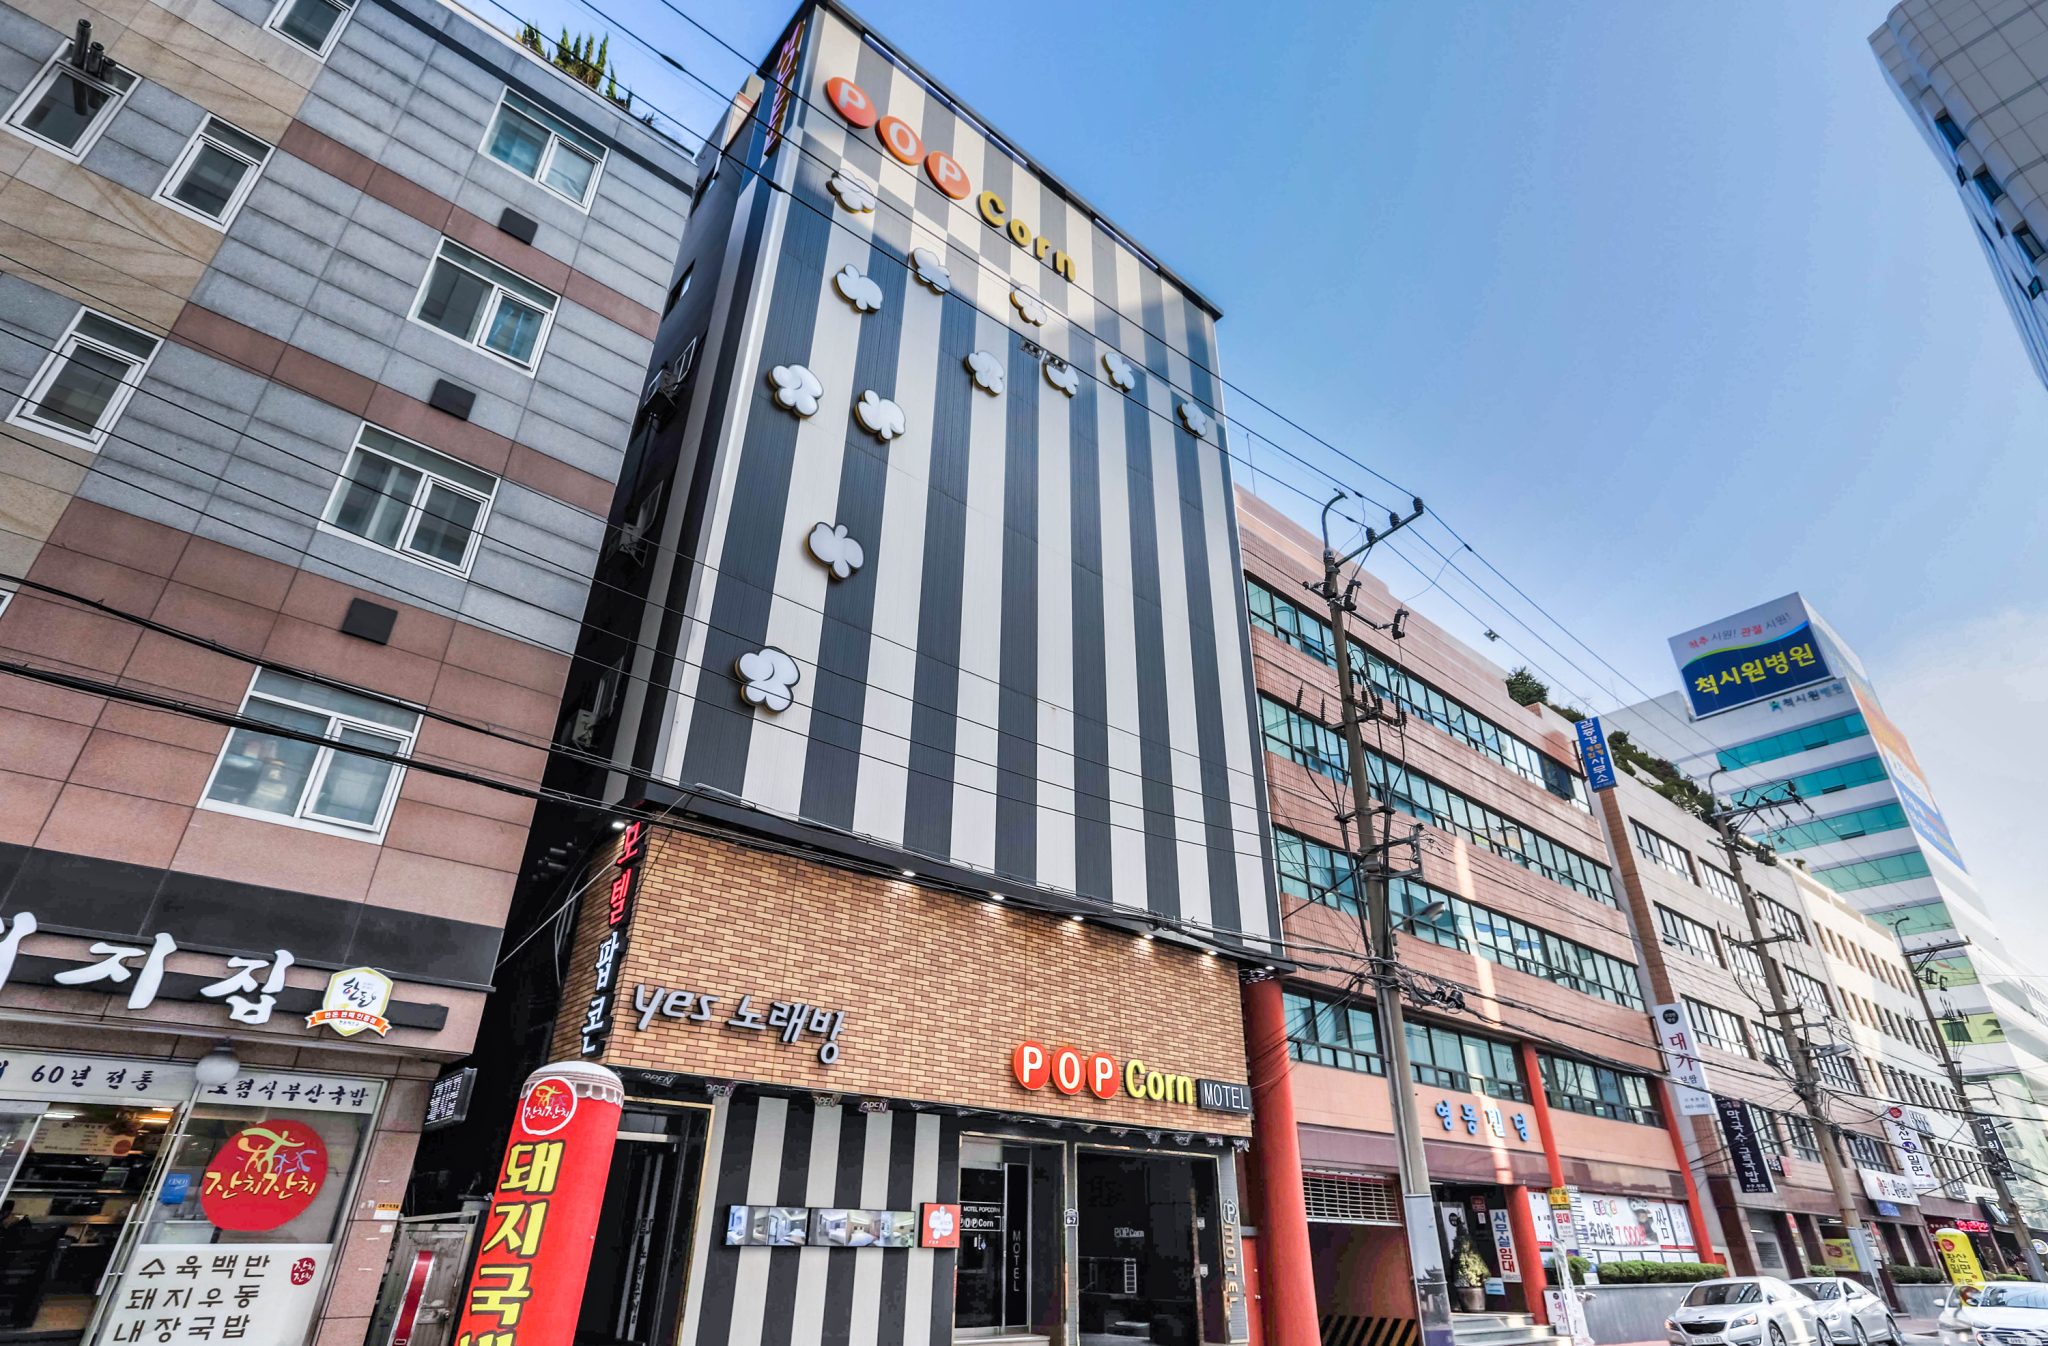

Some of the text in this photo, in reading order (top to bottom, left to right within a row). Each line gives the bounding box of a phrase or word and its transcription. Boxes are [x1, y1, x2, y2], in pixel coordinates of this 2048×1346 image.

[764, 21, 804, 158] MOTEL
[837, 81, 1076, 282] POP Corn
[1689, 612, 1792, 648] 척추 시원! 관절 시원!
[1694, 643, 1816, 695] 척시원병원
[1782, 682, 1845, 707] 척시원병원
[581, 821, 641, 1054] 모텔 팝콘
[0, 911, 295, 1025] 지집
[635, 984, 846, 1064] yes 노래방
[1669, 1032, 1699, 1071] 대가
[31, 1065, 91, 1088] 60년
[106, 1068, 154, 1091] 전통
[1022, 1045, 1249, 1110] POP Corn MOTEL
[860, 1101, 888, 1113] OPEN
[1435, 1100, 1530, 1142] 영동빌딩
[205, 1171, 318, 1200] 잔치잔치
[978, 1218, 994, 1228] Corn
[1494, 1211, 1511, 1247] 사무실
[1556, 1213, 1570, 1223] 임대
[1589, 1221, 1615, 1246] 추어탕
[457, 1140, 566, 1346] 돼지국
[1012, 1230, 1022, 1291] MOTEL
[1499, 1248, 1515, 1273] 임대
[138, 1254, 271, 1280] 수육백반
[125, 1284, 261, 1310] 돼지우동
[112, 1314, 251, 1344] 내장국밥
